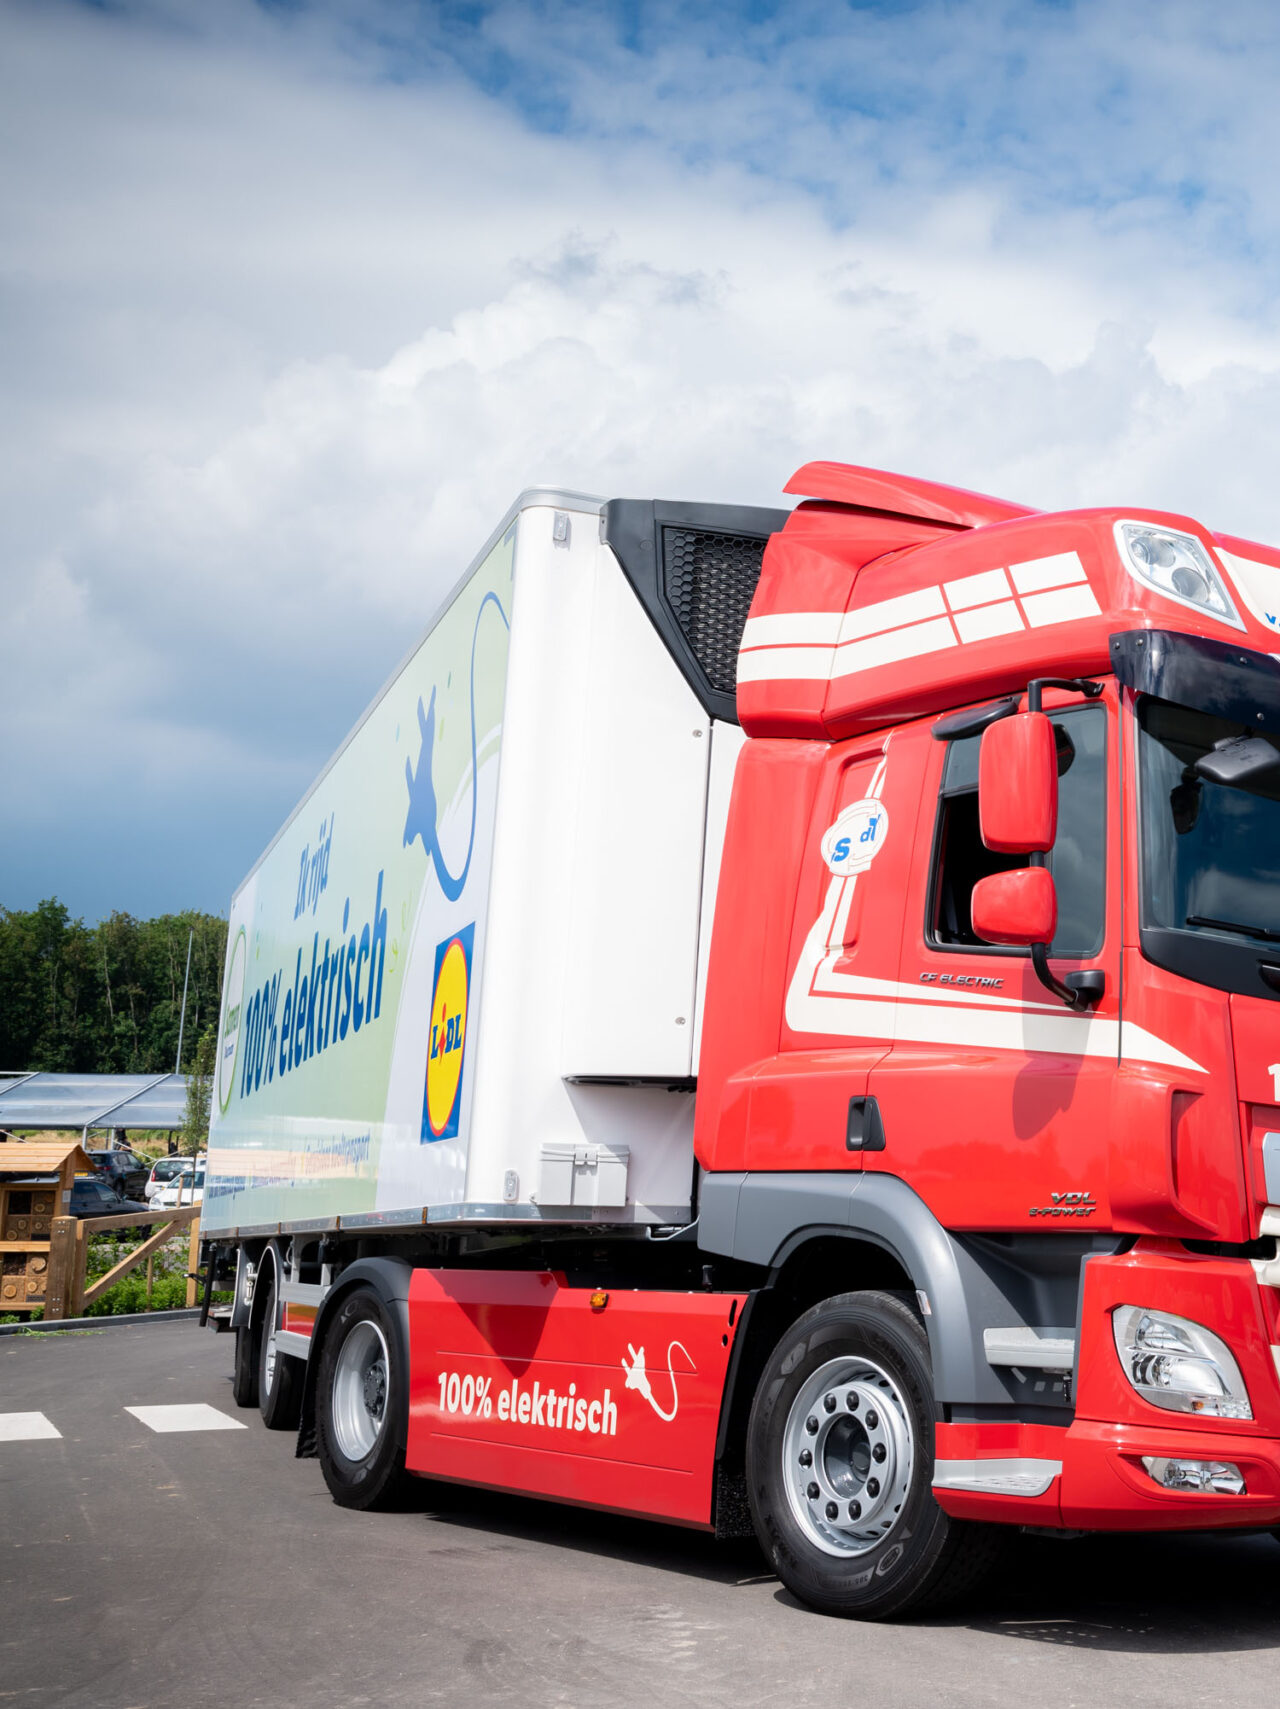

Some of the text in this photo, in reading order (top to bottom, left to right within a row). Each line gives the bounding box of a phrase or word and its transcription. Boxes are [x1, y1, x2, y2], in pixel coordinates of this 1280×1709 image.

[240, 869, 388, 1099] 100% elektrisch
[920, 972, 1004, 988] CF ELECTRIC
[1051, 1192, 1096, 1205] VDL
[438, 1371, 618, 1436] 100% elektrisch
